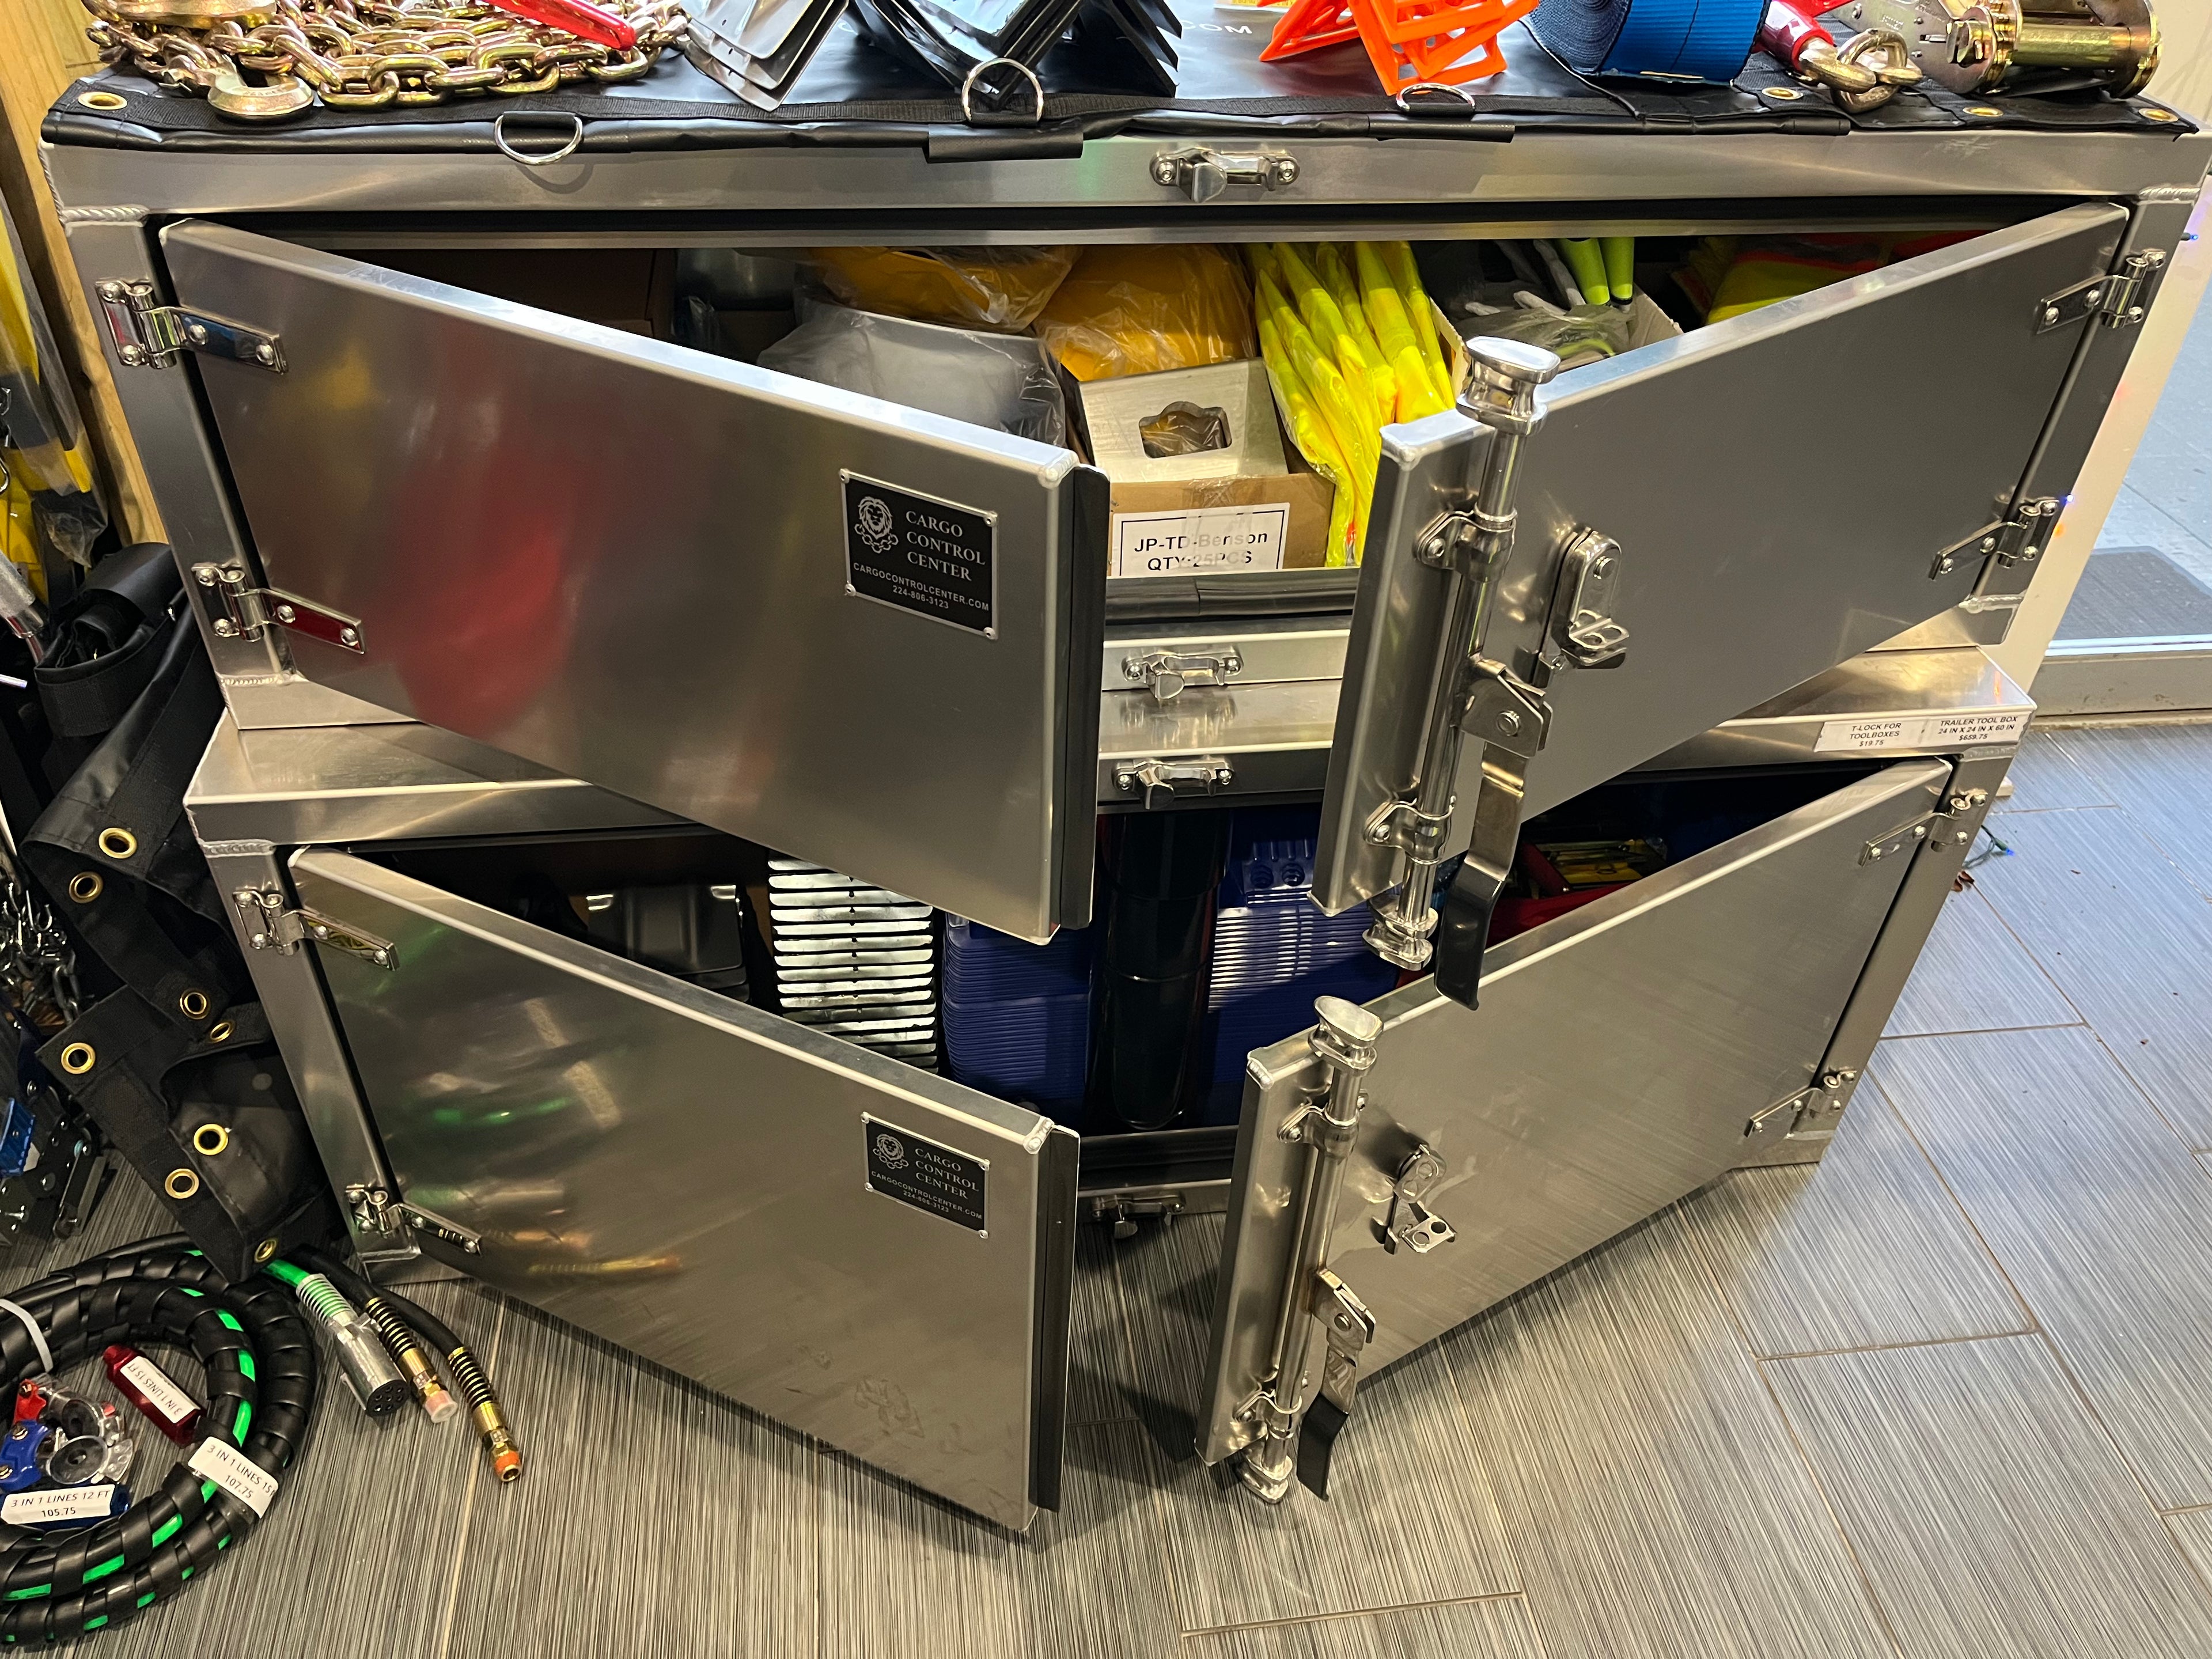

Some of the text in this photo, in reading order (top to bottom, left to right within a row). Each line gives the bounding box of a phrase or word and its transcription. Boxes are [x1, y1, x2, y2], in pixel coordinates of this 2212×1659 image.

[906, 510, 963, 537] CARGO
[907, 531, 986, 565] CONTROL
[1134, 532, 1267, 552] JP-TD-Benson
[907, 551, 972, 581] CENTER
[853, 562, 989, 611] CARGOCONTROLCENTER.COM
[893, 585, 949, 609] 224-806-3123
[1852, 724, 1883, 732] T-LOCK
[1941, 718, 1975, 726] TRAILER
[1850, 730, 1899, 740] TOOLBOXES
[915, 1147, 961, 1172] CARGO
[915, 1160, 979, 1192] CONTROL
[915, 1172, 968, 1199] CENTER
[871, 1171, 982, 1219] CARGOCONTROLCENTER.COM
[903, 1190, 949, 1213] 224-806-3123
[127, 1363, 139, 1373] FT
[143, 1378, 164, 1397] LINES
[165, 1399, 177, 1411] IN
[173, 1407, 182, 1415] 3
[207, 1445, 215, 1453] 3
[216, 1450, 230, 1461] IN
[230, 1459, 235, 1467] 1
[237, 1463, 262, 1484] LINES
[225, 1475, 254, 1498] 107.75
[11, 1499, 17, 1508] 3
[21, 1498, 34, 1506] IN
[47, 1493, 77, 1503] LINES
[82, 1492, 93, 1500] 12
[97, 1490, 111, 1498] FT
[41, 1507, 76, 1517] 105.75
